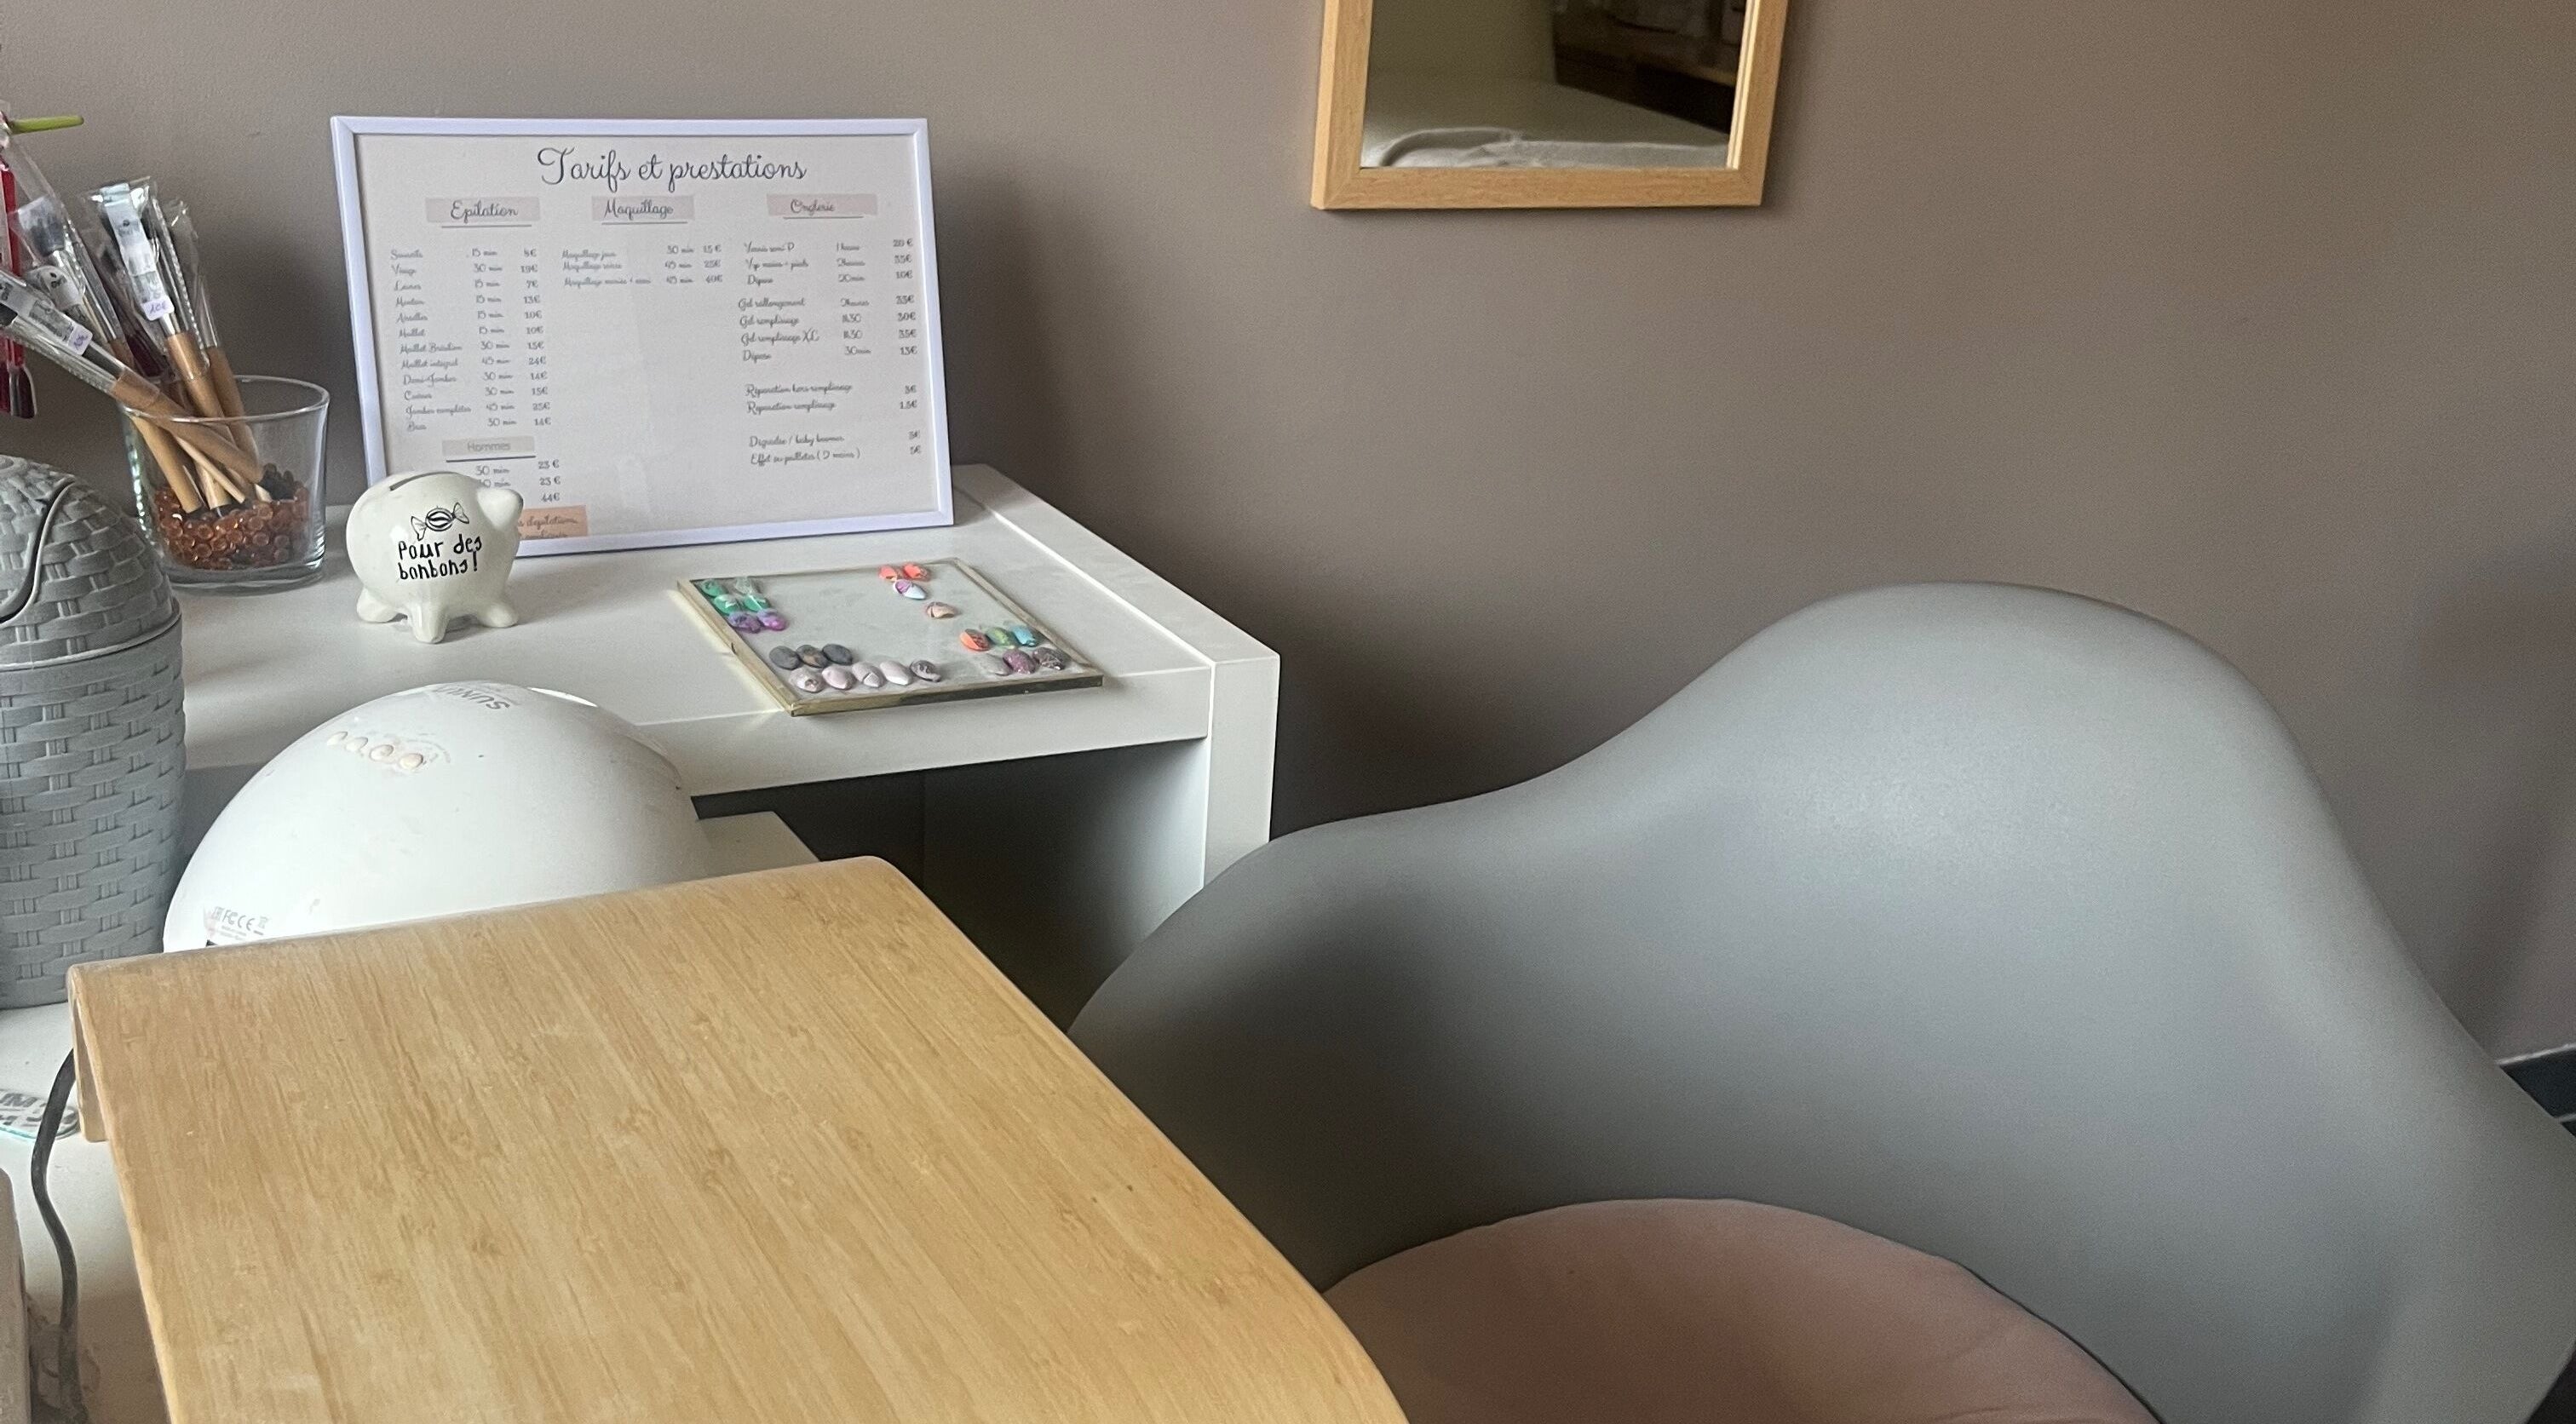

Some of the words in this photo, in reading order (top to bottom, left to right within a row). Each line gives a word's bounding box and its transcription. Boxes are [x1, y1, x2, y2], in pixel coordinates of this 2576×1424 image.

[537, 146, 631, 193] Tarifs
[638, 154, 664, 180] et
[670, 153, 807, 193] prestations
[450, 199, 519, 224] Epilation
[604, 200, 674, 221] Maquillage
[791, 199, 835, 216] Onglerie
[467, 442, 511, 452] Hommes
[399, 541, 444, 560] Pour
[453, 534, 482, 554] des
